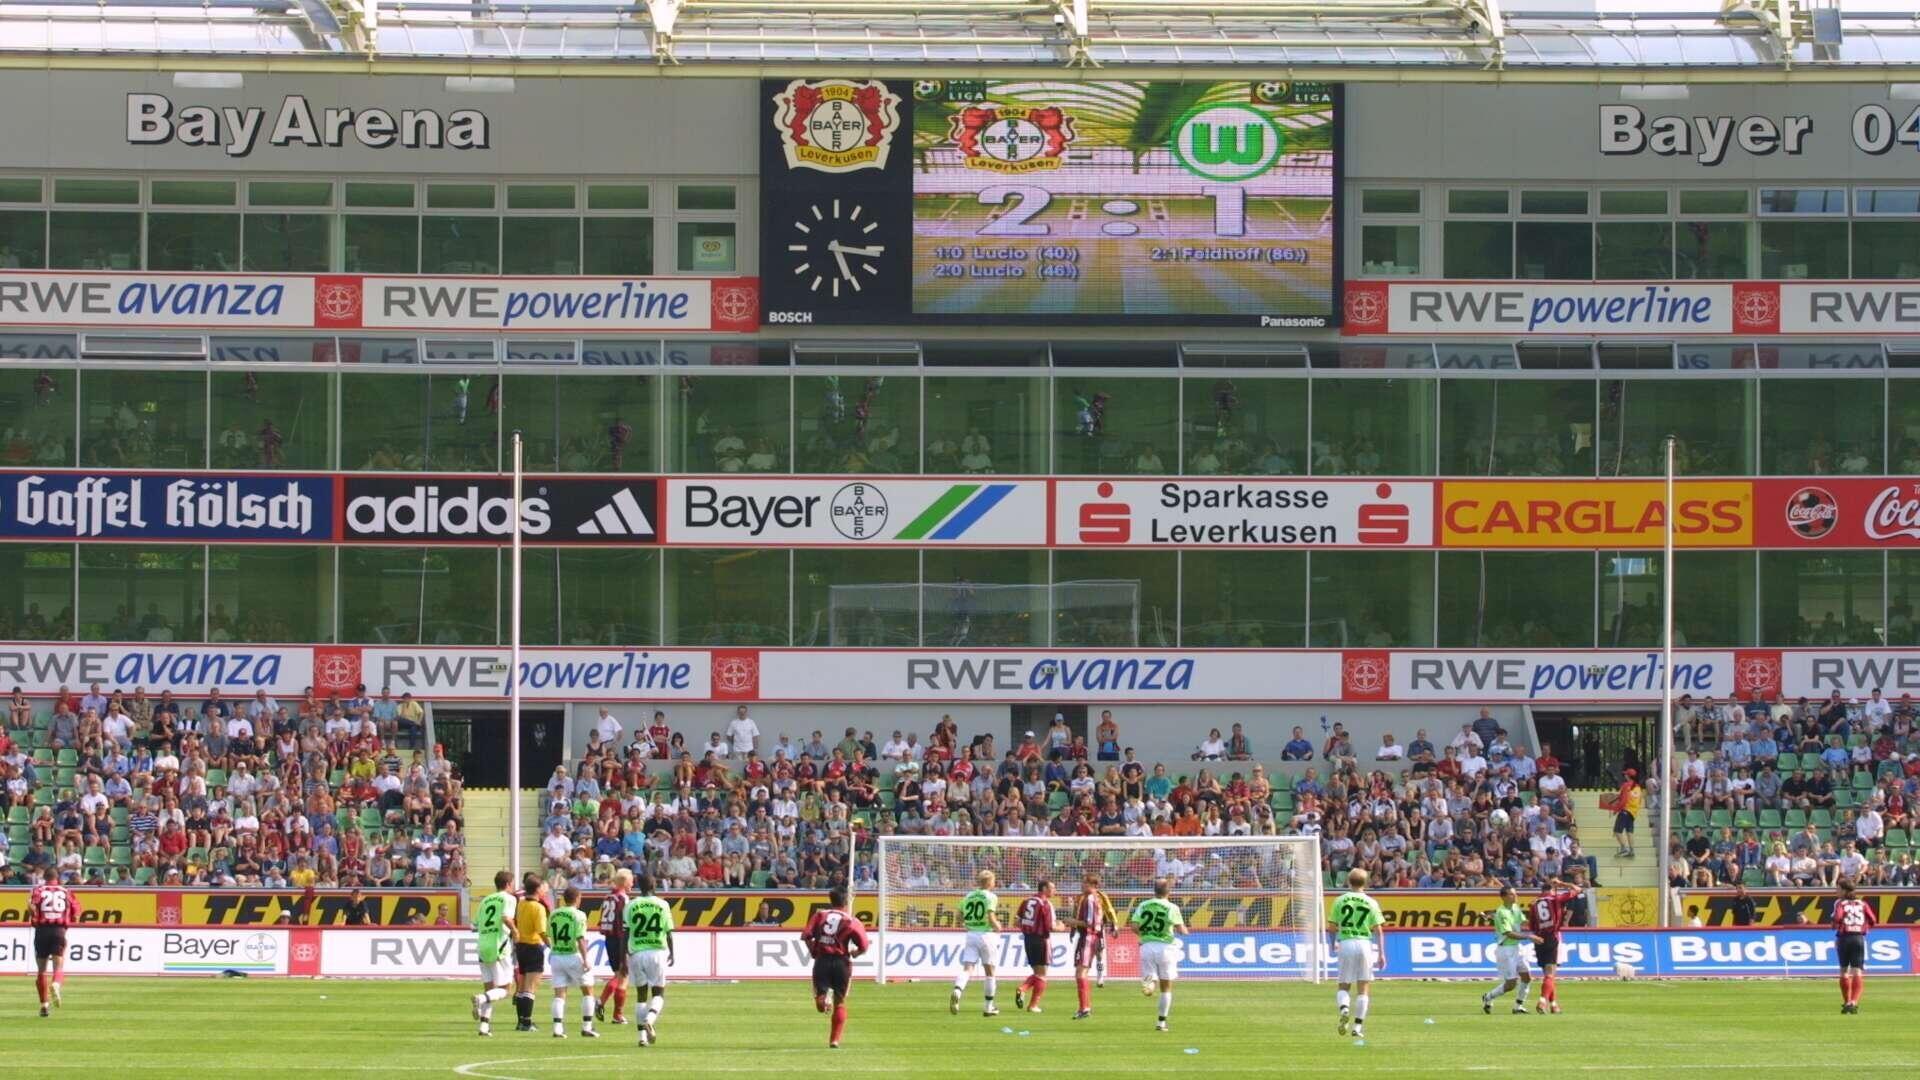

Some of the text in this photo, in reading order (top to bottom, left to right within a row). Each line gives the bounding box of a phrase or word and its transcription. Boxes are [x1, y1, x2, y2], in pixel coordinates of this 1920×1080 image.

[126, 92, 490, 157] BayArena
[1599, 104, 1920, 166] Bayer 04
[800, 147, 873, 164] Leverkusen
[976, 184, 1053, 236] 2
[1202, 185, 1246, 237] 1
[973, 246, 1028, 260] Lucio
[970, 264, 1025, 278] Lucio
[118, 282, 285, 316] avanza
[383, 286, 500, 318] RWE
[502, 282, 690, 326] powerline
[1409, 291, 1525, 323] RWE
[1528, 286, 1712, 332] powerline
[1809, 291, 1920, 323] RWE
[768, 311, 813, 323] BOSCH
[1260, 315, 1326, 327] Panasonic
[16, 475, 313, 537] Gaffel Kölsch
[685, 485, 822, 536] Bayer
[1159, 483, 1329, 513] Sparkasse
[1150, 518, 1337, 544] Leverkusen
[115, 652, 282, 686] avanza
[383, 655, 499, 688] RWE
[906, 658, 1195, 691] RWE avanza
[1410, 659, 1526, 690] RWE
[1811, 658, 1920, 690] RWE
[40, 890, 67, 913] 26
[964, 900, 985, 921] 20
[1024, 899, 1037, 920] 5
[1535, 900, 1551, 922] 6
[1843, 902, 1866, 926] 35
[483, 905, 497, 928] 2
[631, 912, 664, 938] 24
[823, 912, 842, 935] 9
[1139, 909, 1167, 933] 25
[1340, 904, 1371, 929] 27
[163, 933, 240, 959] Bayer
[550, 922, 572, 944] 14
